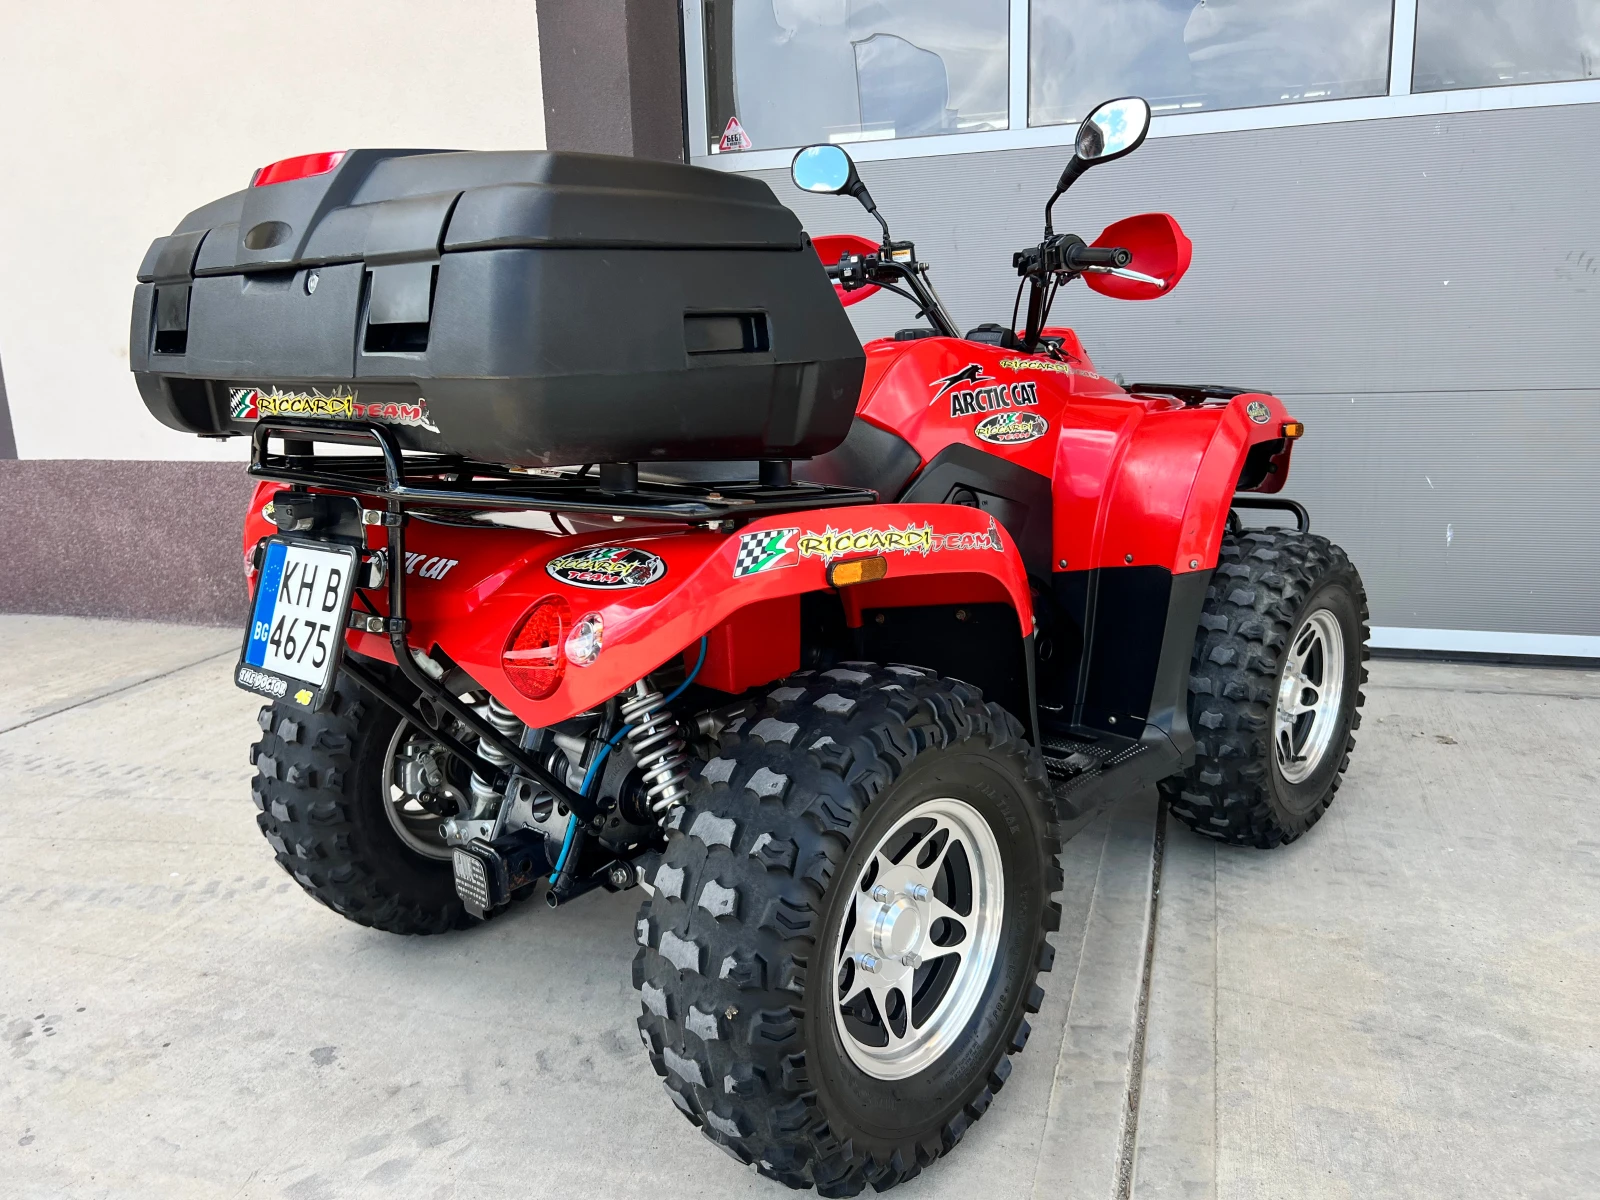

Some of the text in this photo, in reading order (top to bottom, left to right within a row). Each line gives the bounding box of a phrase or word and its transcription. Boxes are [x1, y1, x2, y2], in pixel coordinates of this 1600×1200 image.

[1001, 359, 1068, 373] RICCARDI
[257, 396, 420, 419] RICCARDI TEAM
[951, 382, 1038, 417] ARCTIC CAT
[976, 422, 1033, 437] RICCARDI
[997, 432, 1031, 441] TEAM
[800, 530, 990, 553] RICCARDI TEAM
[419, 556, 459, 580] CAT
[548, 556, 637, 575] RICCARDI
[279, 560, 342, 612] KH B
[568, 571, 621, 583] TEAM
[253, 621, 270, 641] BG
[269, 615, 331, 669] 4675
[239, 668, 287, 697] THE DOCTOR
[294, 689, 313, 705] 46
